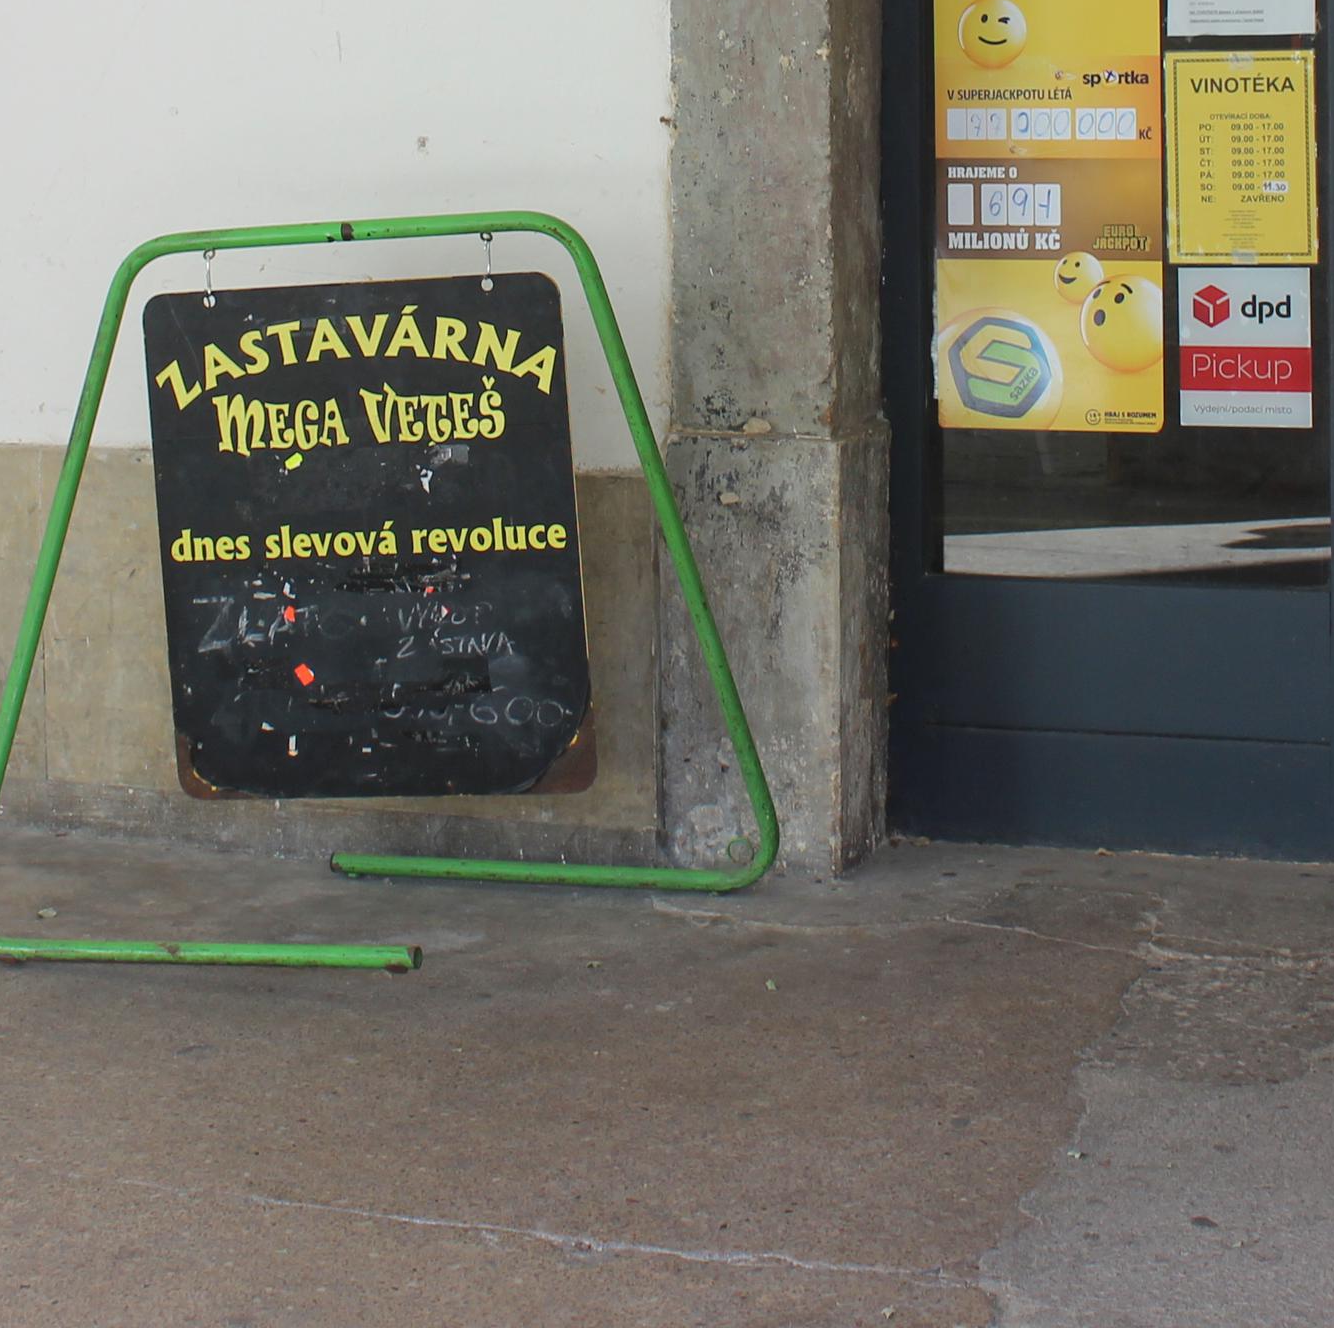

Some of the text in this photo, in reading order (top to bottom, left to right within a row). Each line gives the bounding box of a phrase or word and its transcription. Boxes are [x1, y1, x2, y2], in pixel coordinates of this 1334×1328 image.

[1190, 73, 1295, 94] VINOTÉKA
[947, 87, 1073, 101] V SUPERJACKPOTU LÉTÁ
[1139, 125, 1153, 140] KČ
[1231, 146, 1254, 154] 09.00
[1262, 146, 1284, 154] 17.00
[1262, 158, 1284, 166] 17.00
[947, 166, 1005, 178] HRAJEME
[1232, 183, 1255, 191] 09.00
[1241, 194, 1284, 203] ZAVŘENO
[1103, 225, 1136, 237] EURO
[948, 228, 1061, 250] MILIONŮ KČ
[1092, 236, 1150, 252] JACKPOT
[1241, 294, 1292, 324] dpd
[155, 305, 557, 411] ZASTAVÁRNA
[1192, 353, 1293, 385] Pickup
[1009, 366, 1039, 401] sazka
[1193, 403, 1293, 415] Výdejní/podací místo
[212, 376, 506, 458] MEGA VETEŠ
[170, 517, 567, 563] dnes slevová revoluce
